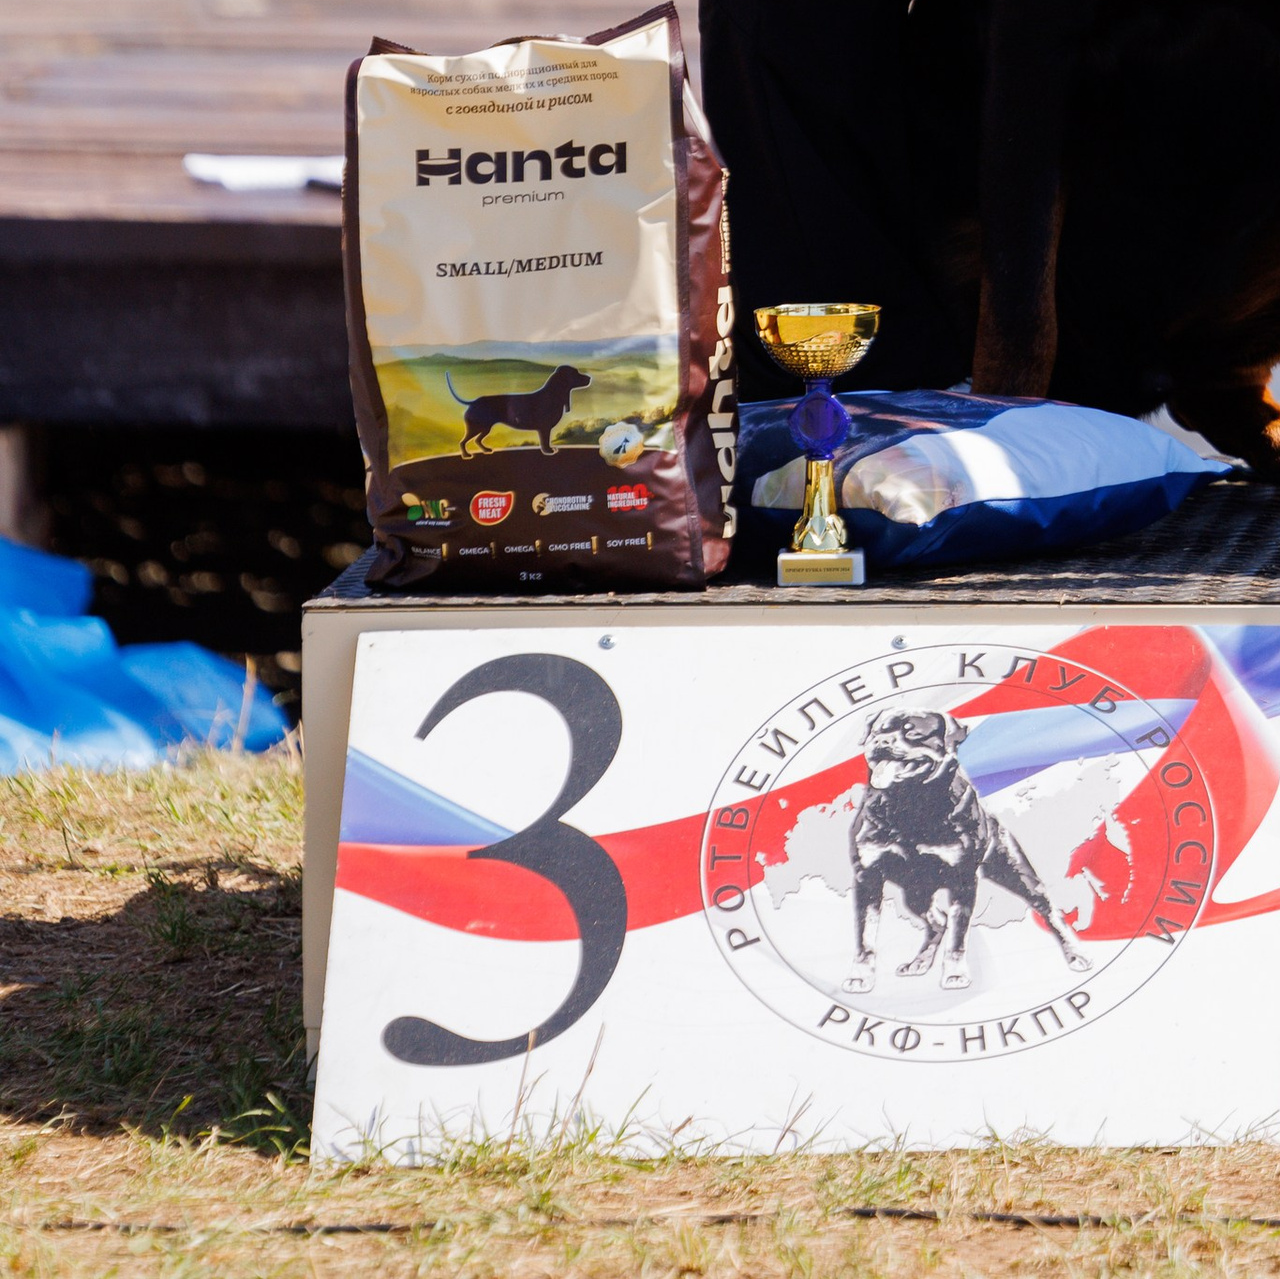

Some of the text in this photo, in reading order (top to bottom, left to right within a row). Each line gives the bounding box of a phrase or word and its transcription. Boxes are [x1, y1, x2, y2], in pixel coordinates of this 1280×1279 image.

[427, 73, 452, 84] Корм
[454, 70, 486, 83] сухой
[580, 59, 598, 69] для
[410, 86, 460, 97] взрослых
[462, 83, 493, 95] собак
[546, 74, 588, 88] средних
[590, 70, 620, 82] пород
[446, 91, 594, 115] с говядиной и рисом
[415, 139, 627, 187] Hanta
[482, 191, 565, 207] premium
[435, 251, 604, 278] SMALL/MEDIUM
[478, 497, 506, 508] FRESH
[607, 492, 635, 501] NATURAL
[607, 498, 648, 508] INGREDIENTS
[478, 508, 502, 519] MEAT
[504, 545, 535, 553] OMEGA
[548, 541, 591, 552] GMO FREE
[607, 537, 646, 548] SOY FREE
[459, 546, 489, 556] OMEGA
[519, 572, 527, 581] 3
[709, 652, 1209, 954] РОТВЕЙЛЕР КЛУБ РОССИИ
[380, 653, 628, 1067] 3
[816, 989, 1093, 1055] РКФ-НКПР
